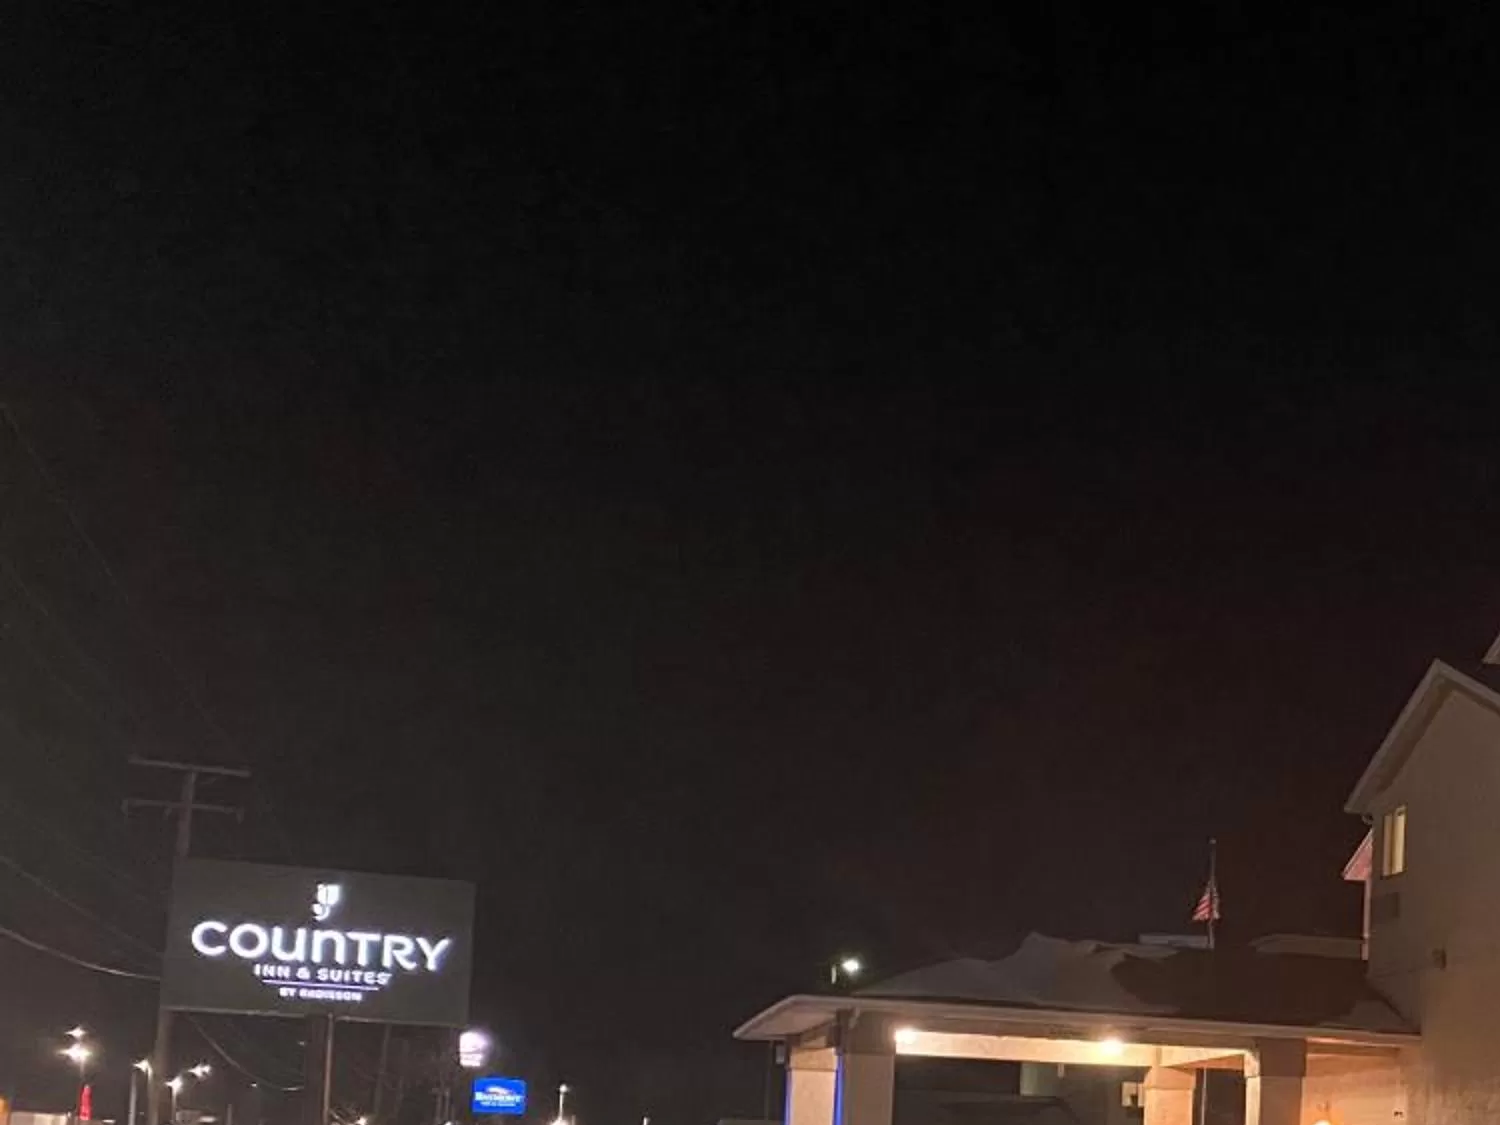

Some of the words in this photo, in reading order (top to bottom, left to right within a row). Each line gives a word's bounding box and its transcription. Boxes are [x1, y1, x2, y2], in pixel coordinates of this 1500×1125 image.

[191, 920, 451, 971] COUNTRY
[253, 963, 291, 979] INN
[296, 966, 311, 980] &
[316, 967, 393, 985] SUITES
[279, 987, 297, 997] BY
